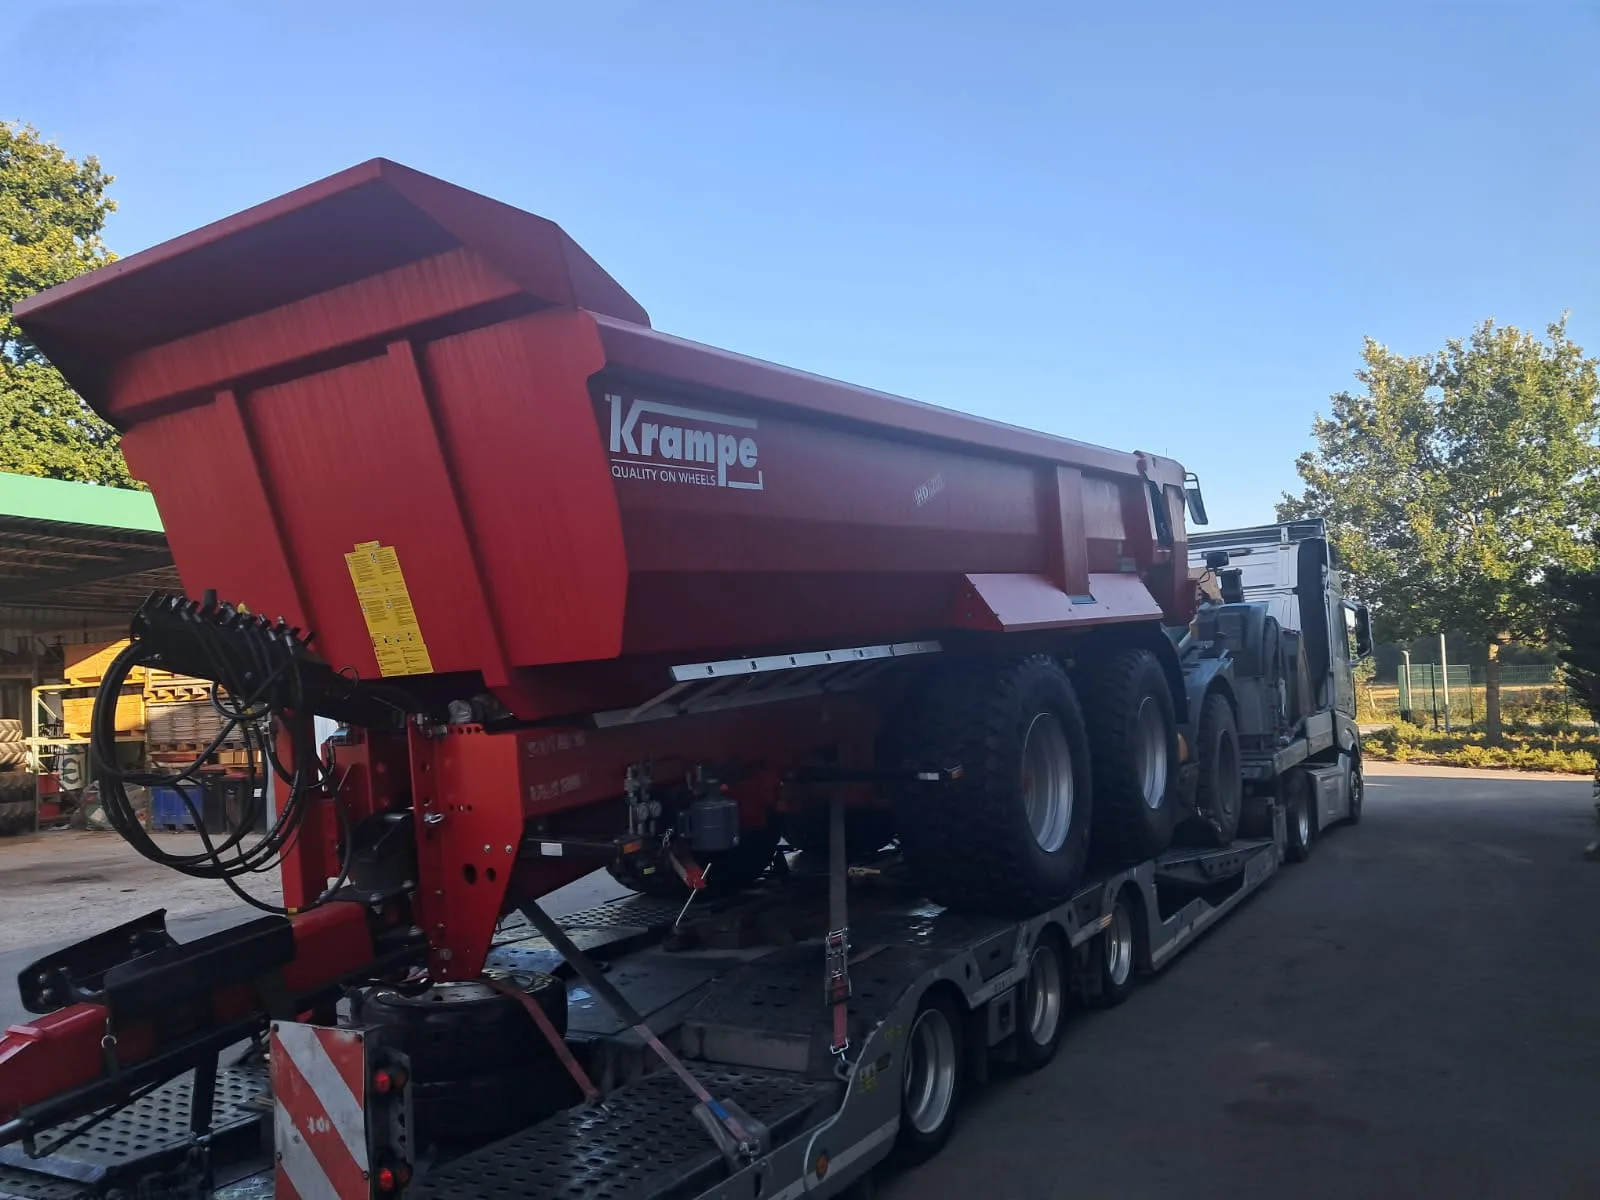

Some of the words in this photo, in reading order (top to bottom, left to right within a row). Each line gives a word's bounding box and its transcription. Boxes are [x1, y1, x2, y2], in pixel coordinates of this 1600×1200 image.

[609, 394, 758, 487] Krampe
[611, 465, 657, 481] QUALITY
[660, 470, 677, 482] ON
[678, 471, 716, 486] WHEELS
